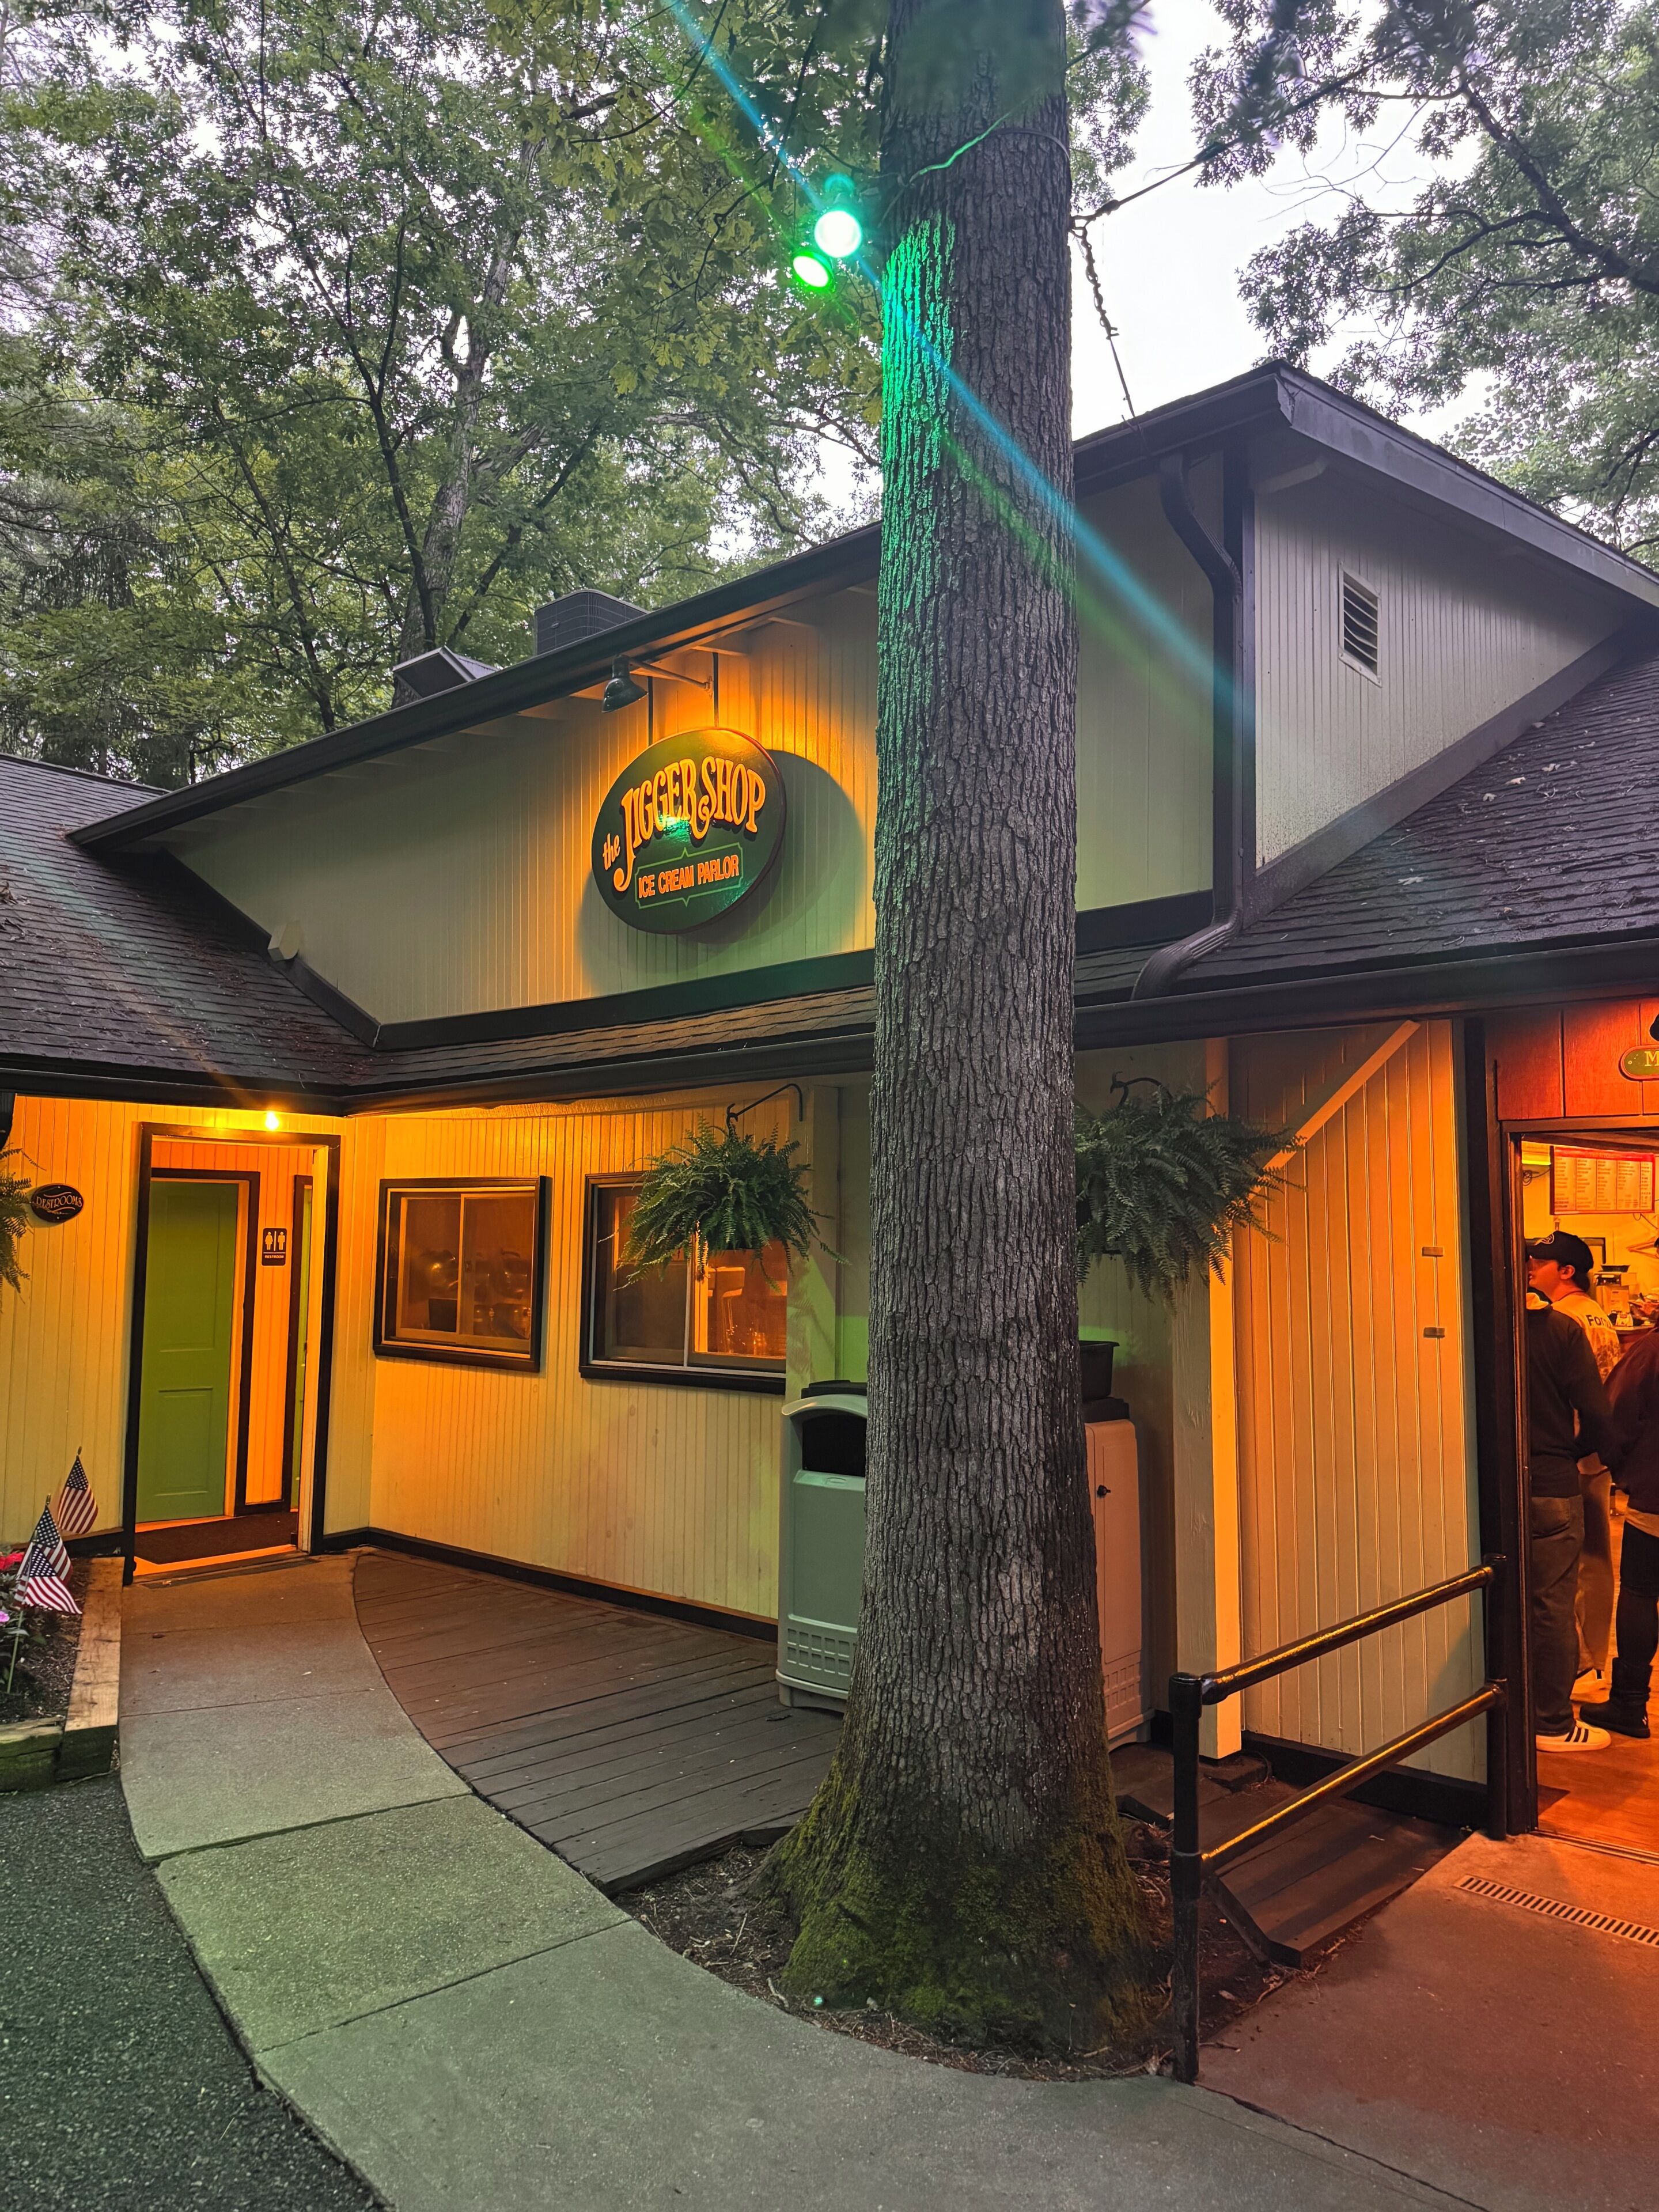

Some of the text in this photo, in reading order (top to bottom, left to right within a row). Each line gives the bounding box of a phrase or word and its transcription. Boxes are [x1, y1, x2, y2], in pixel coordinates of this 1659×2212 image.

[603, 756, 766, 892] the JIGGER SHOP
[638, 854, 740, 899] ICE CREAM PARLOR
[36, 1194, 83, 1209] RESTROOMS
